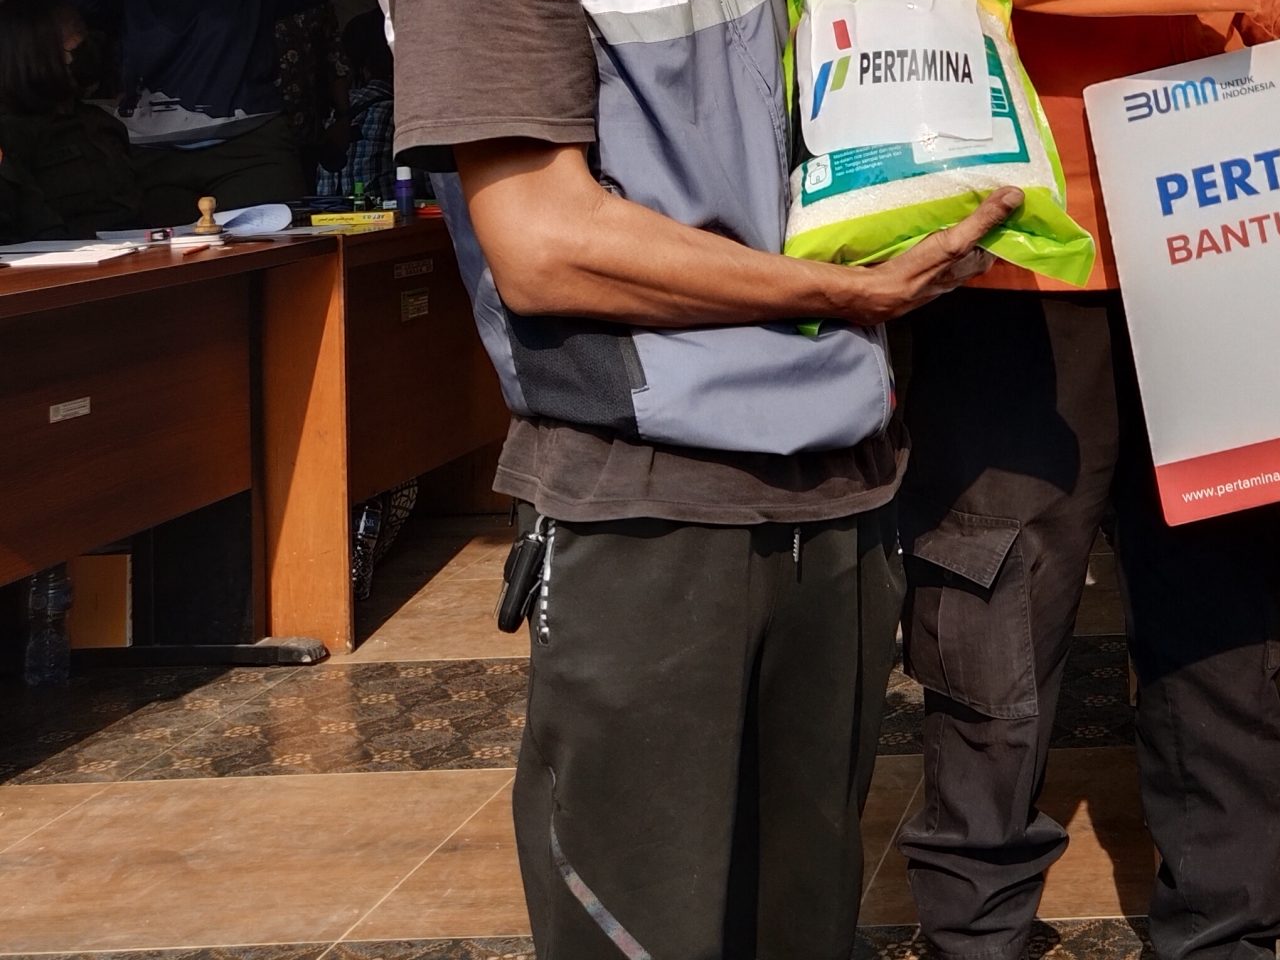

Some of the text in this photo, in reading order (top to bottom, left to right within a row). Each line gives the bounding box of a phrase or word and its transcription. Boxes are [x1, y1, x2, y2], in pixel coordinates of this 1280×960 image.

[858, 48, 974, 86] PERTAMINA
[1220, 74, 1254, 91] UNTUK
[1222, 80, 1276, 100] INDONESIA
